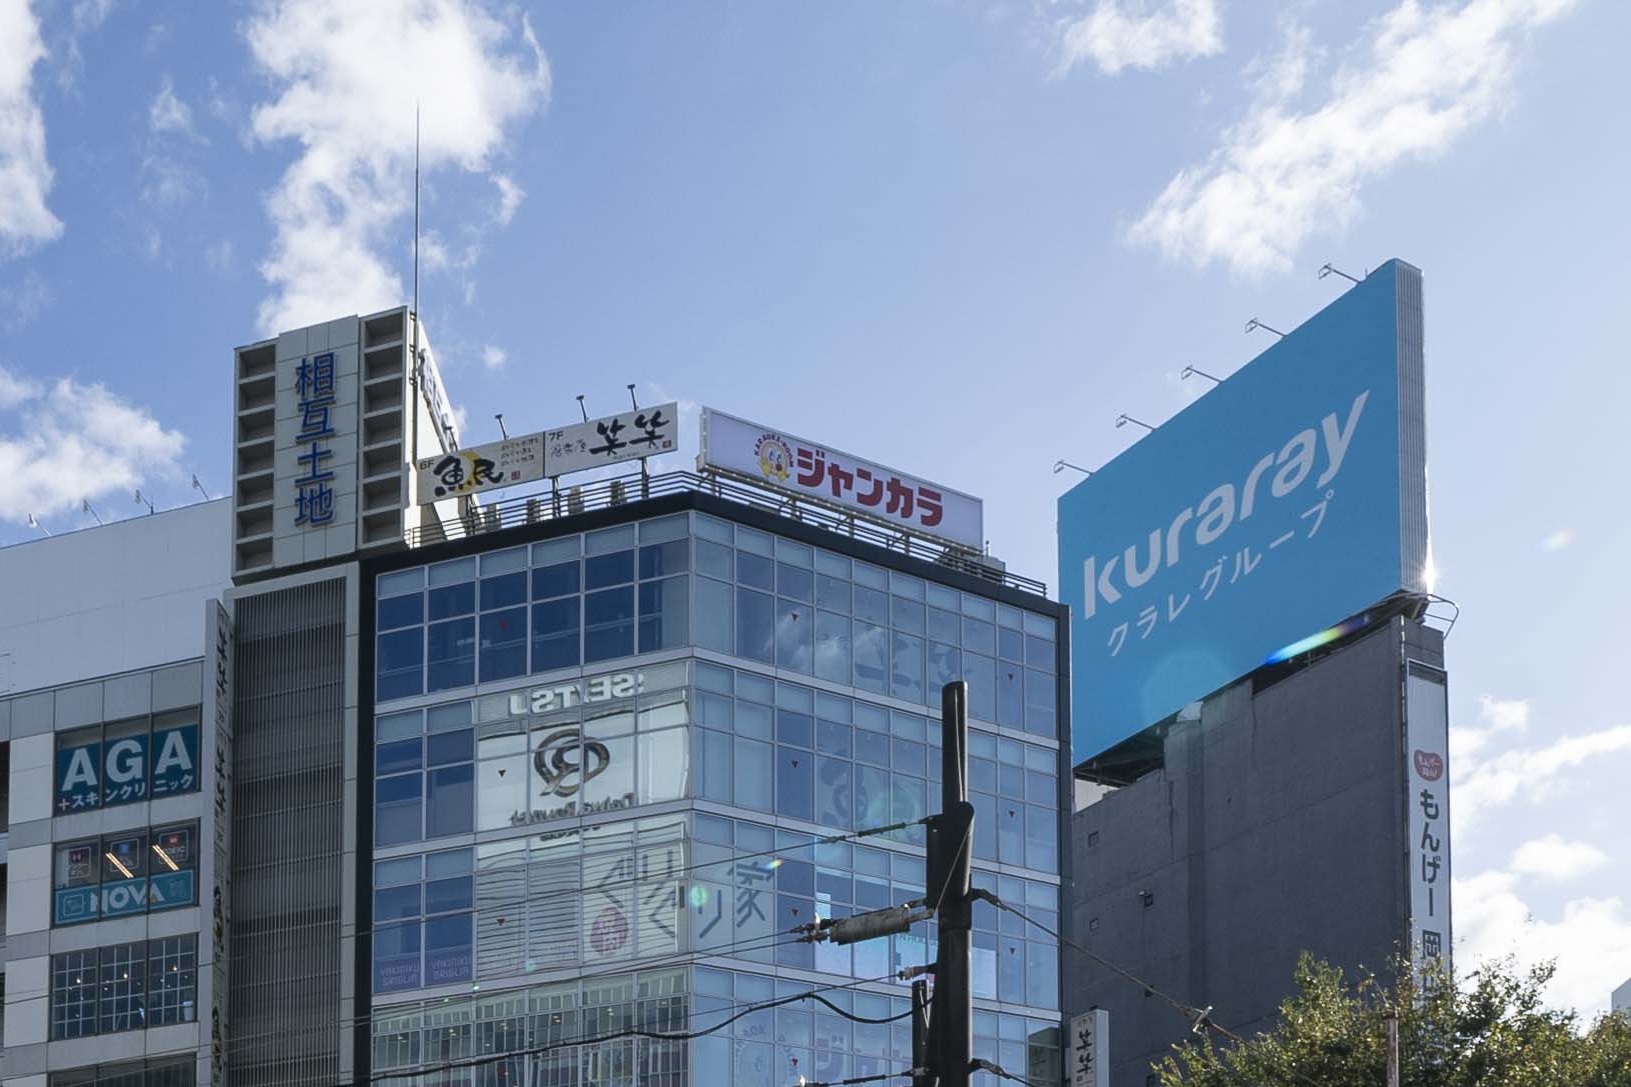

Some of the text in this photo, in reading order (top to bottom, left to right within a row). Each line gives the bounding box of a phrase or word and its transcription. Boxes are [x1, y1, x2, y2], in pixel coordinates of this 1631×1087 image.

[293, 351, 338, 528] 相互土地
[588, 410, 670, 457] 笑笑
[433, 454, 504, 498] 魚民
[797, 446, 943, 528] ジャンカラ
[1083, 389, 1370, 621] kuraray
[1106, 488, 1336, 658] クラレグループ
[61, 730, 194, 793] AGA
[71, 774, 195, 810] スキンクリニック
[89, 880, 166, 914] NOVA
